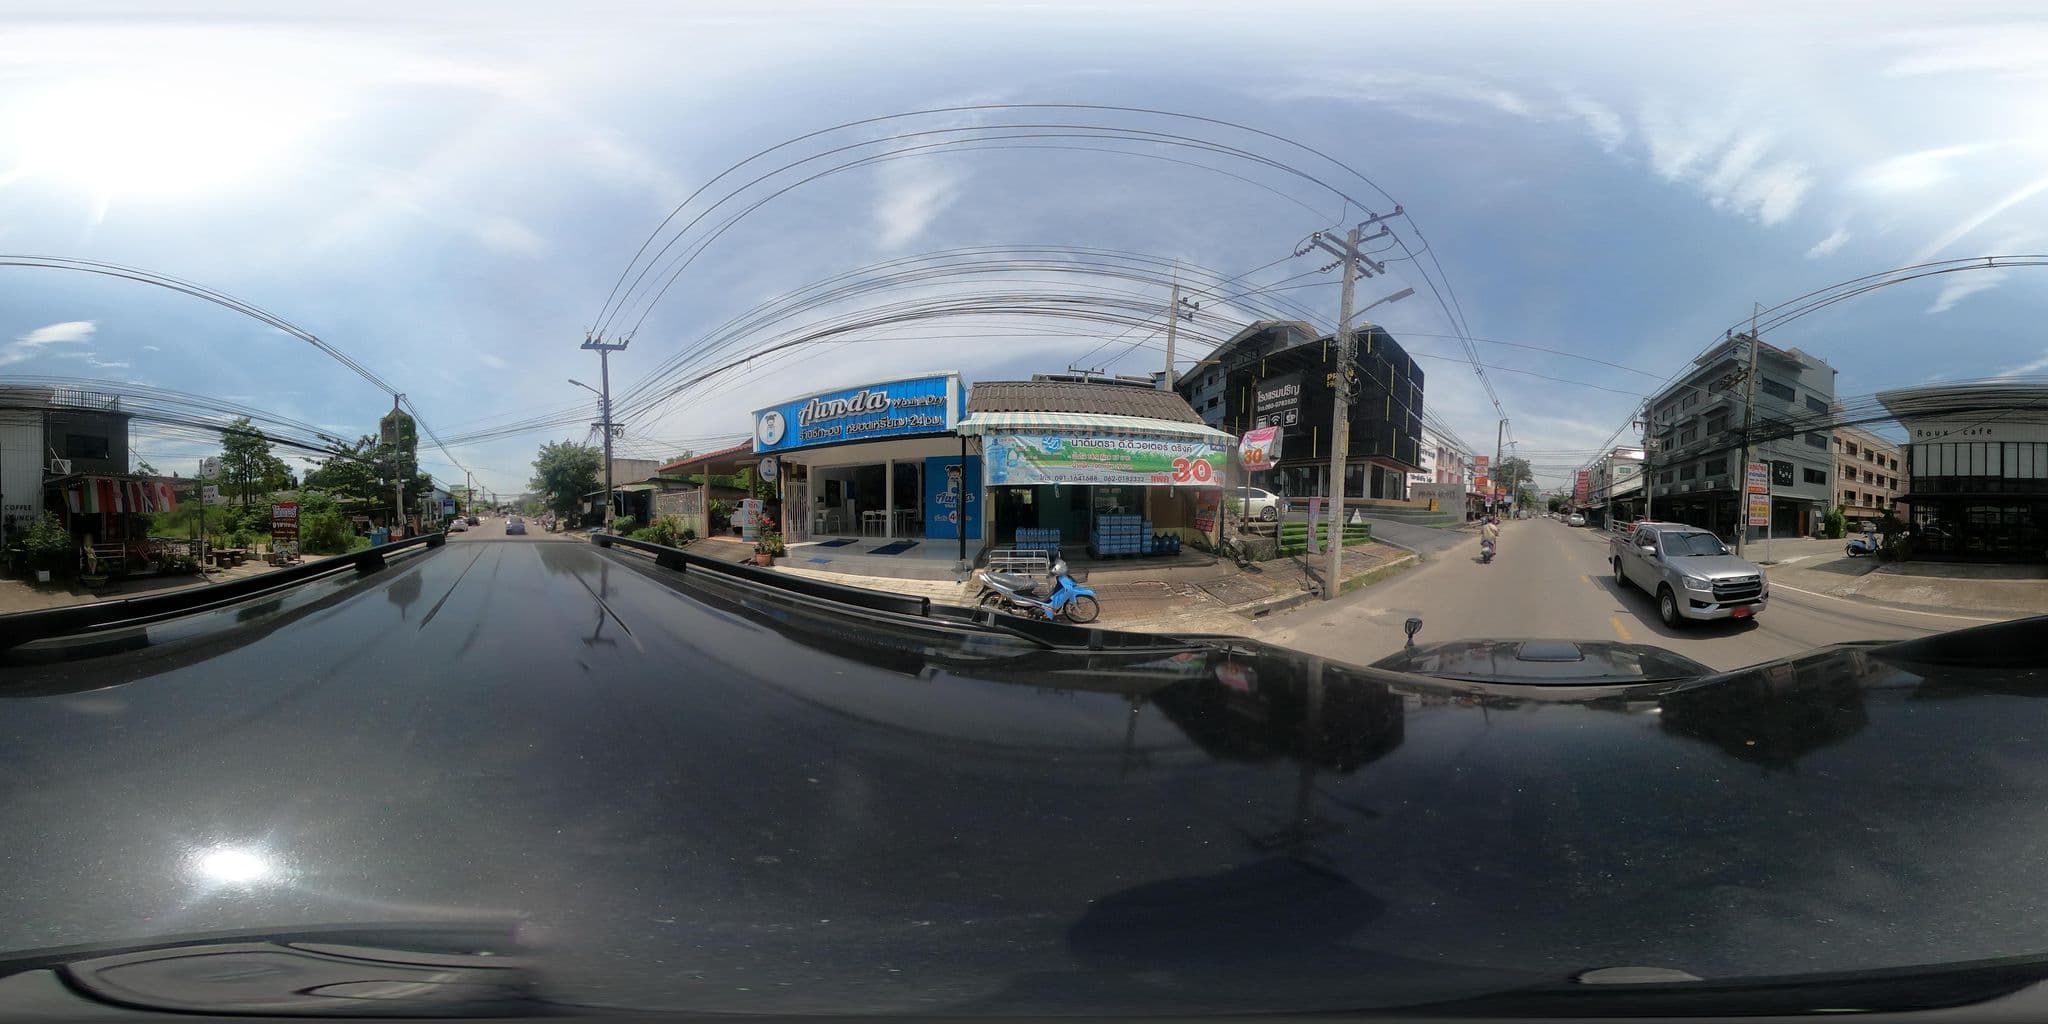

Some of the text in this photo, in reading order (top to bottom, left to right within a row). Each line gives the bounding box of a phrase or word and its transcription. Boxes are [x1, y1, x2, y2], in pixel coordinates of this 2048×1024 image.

[800, 390, 888, 426] Aunda
[1917, 428, 1992, 437] Roux cafe
[1172, 457, 1213, 483] 30
